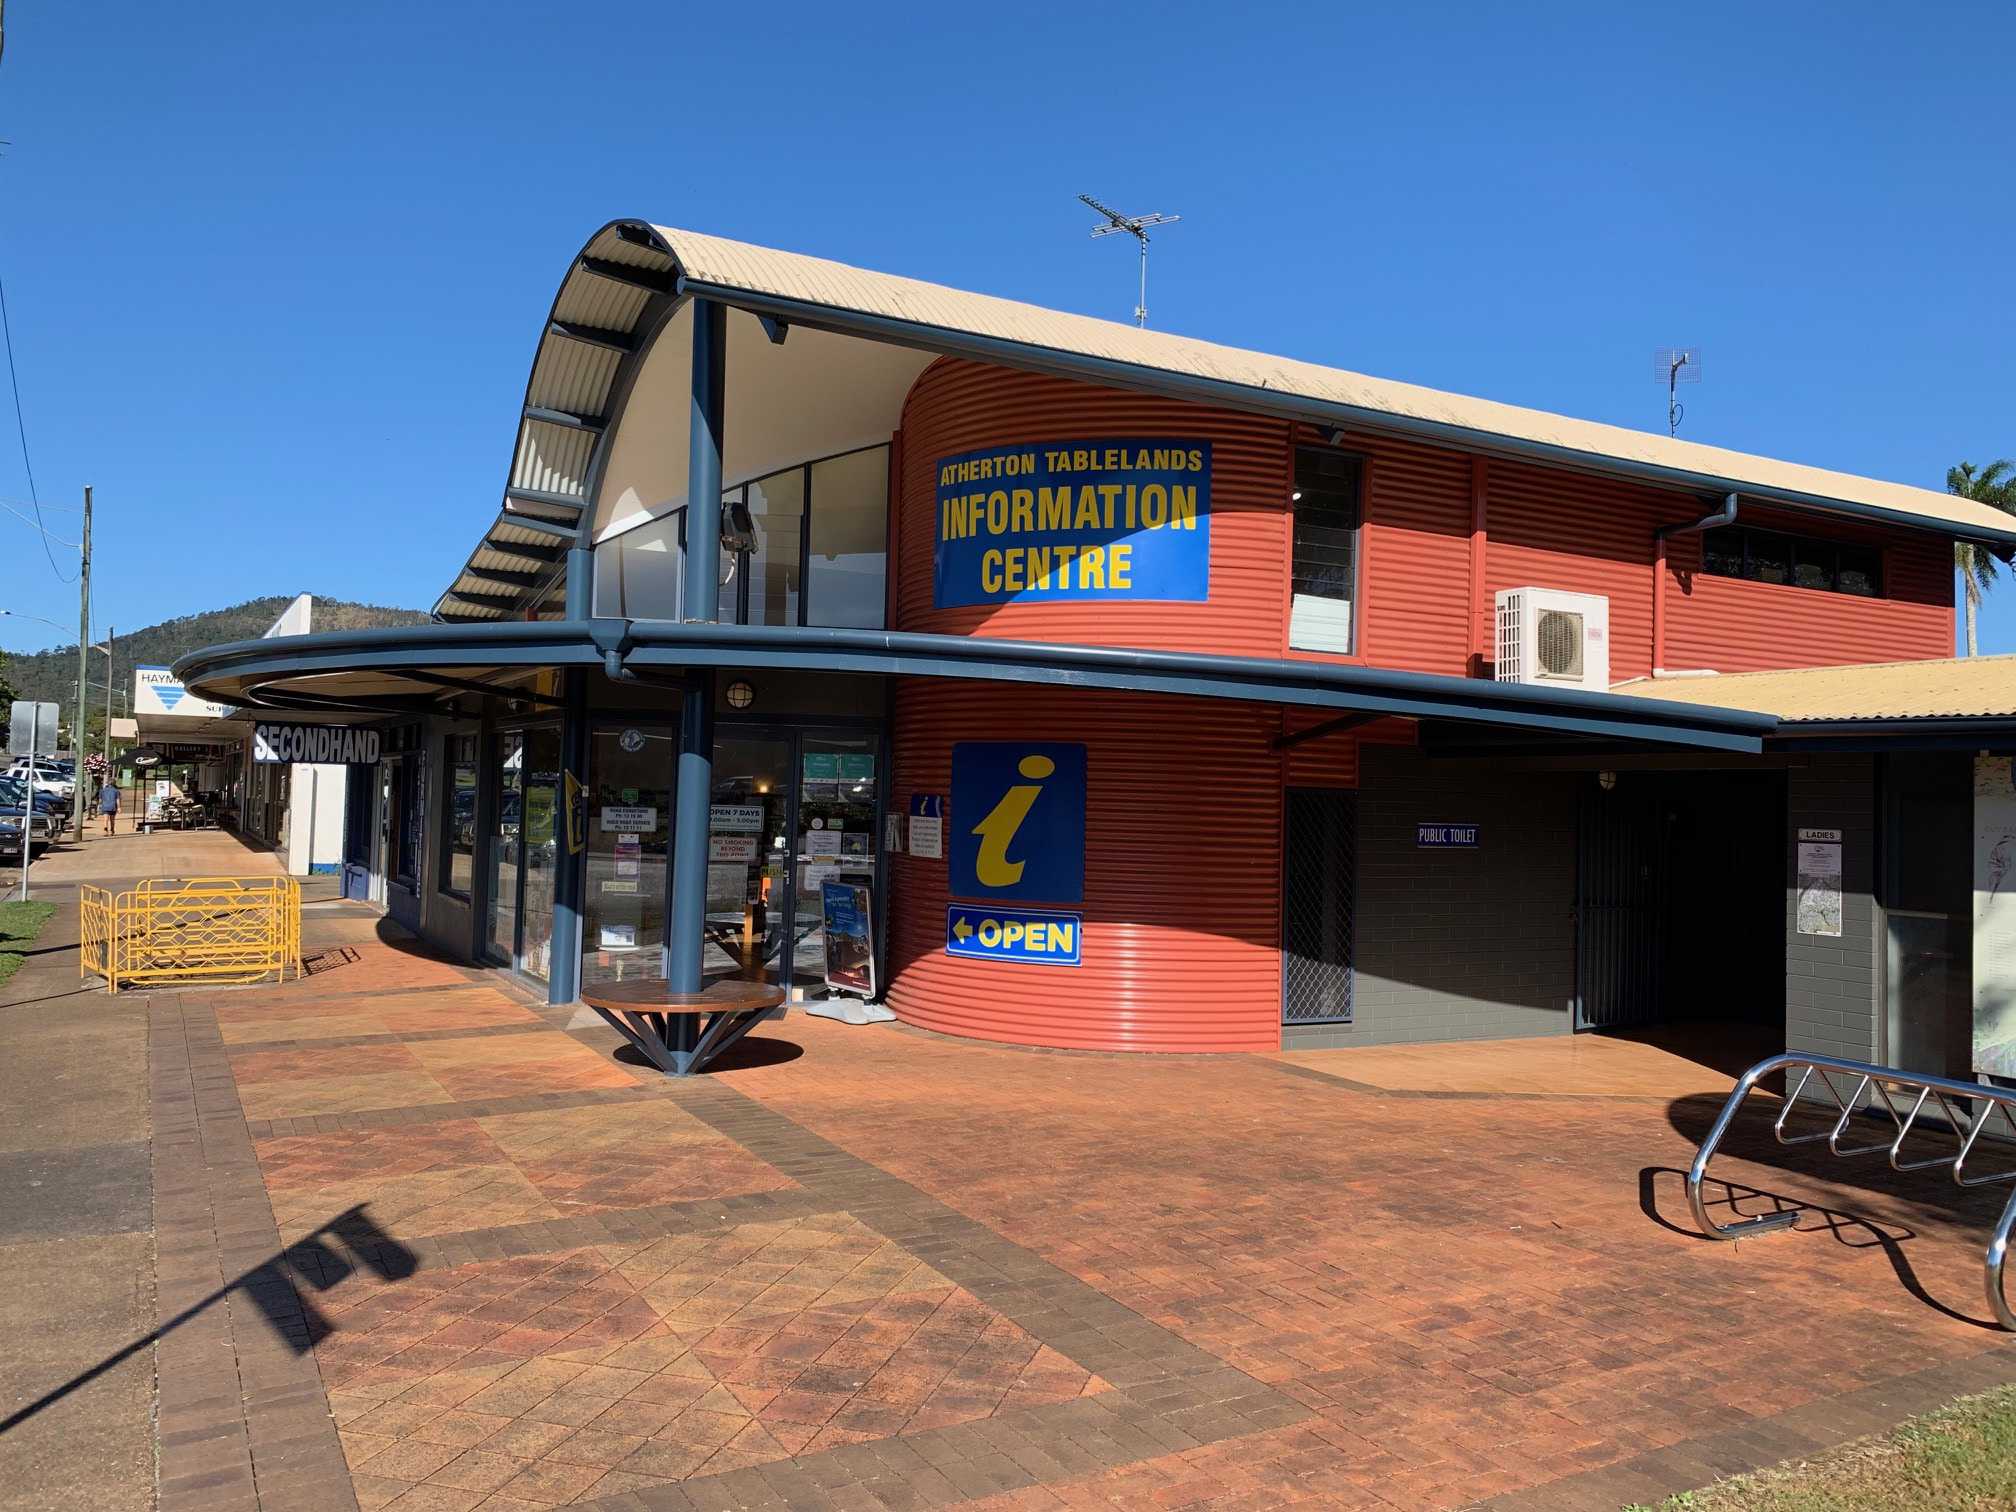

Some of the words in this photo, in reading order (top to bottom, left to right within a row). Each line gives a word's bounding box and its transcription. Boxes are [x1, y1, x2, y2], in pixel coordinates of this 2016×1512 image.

[941, 453, 1035, 486] ATHERTON
[1045, 449, 1203, 473] TABLELANDS
[941, 484, 1197, 542] INFORMATION
[981, 544, 1133, 593] CENTRE
[254, 725, 380, 764] SECONDHAND
[711, 808, 731, 817] OPEN
[732, 809, 739, 817] 7
[740, 808, 760, 817] DAYS
[1419, 828, 1447, 842] PUBLIC
[1450, 828, 1476, 843] TOILET
[1806, 831, 1835, 840] LADIES
[978, 918, 1073, 953] OPEN
